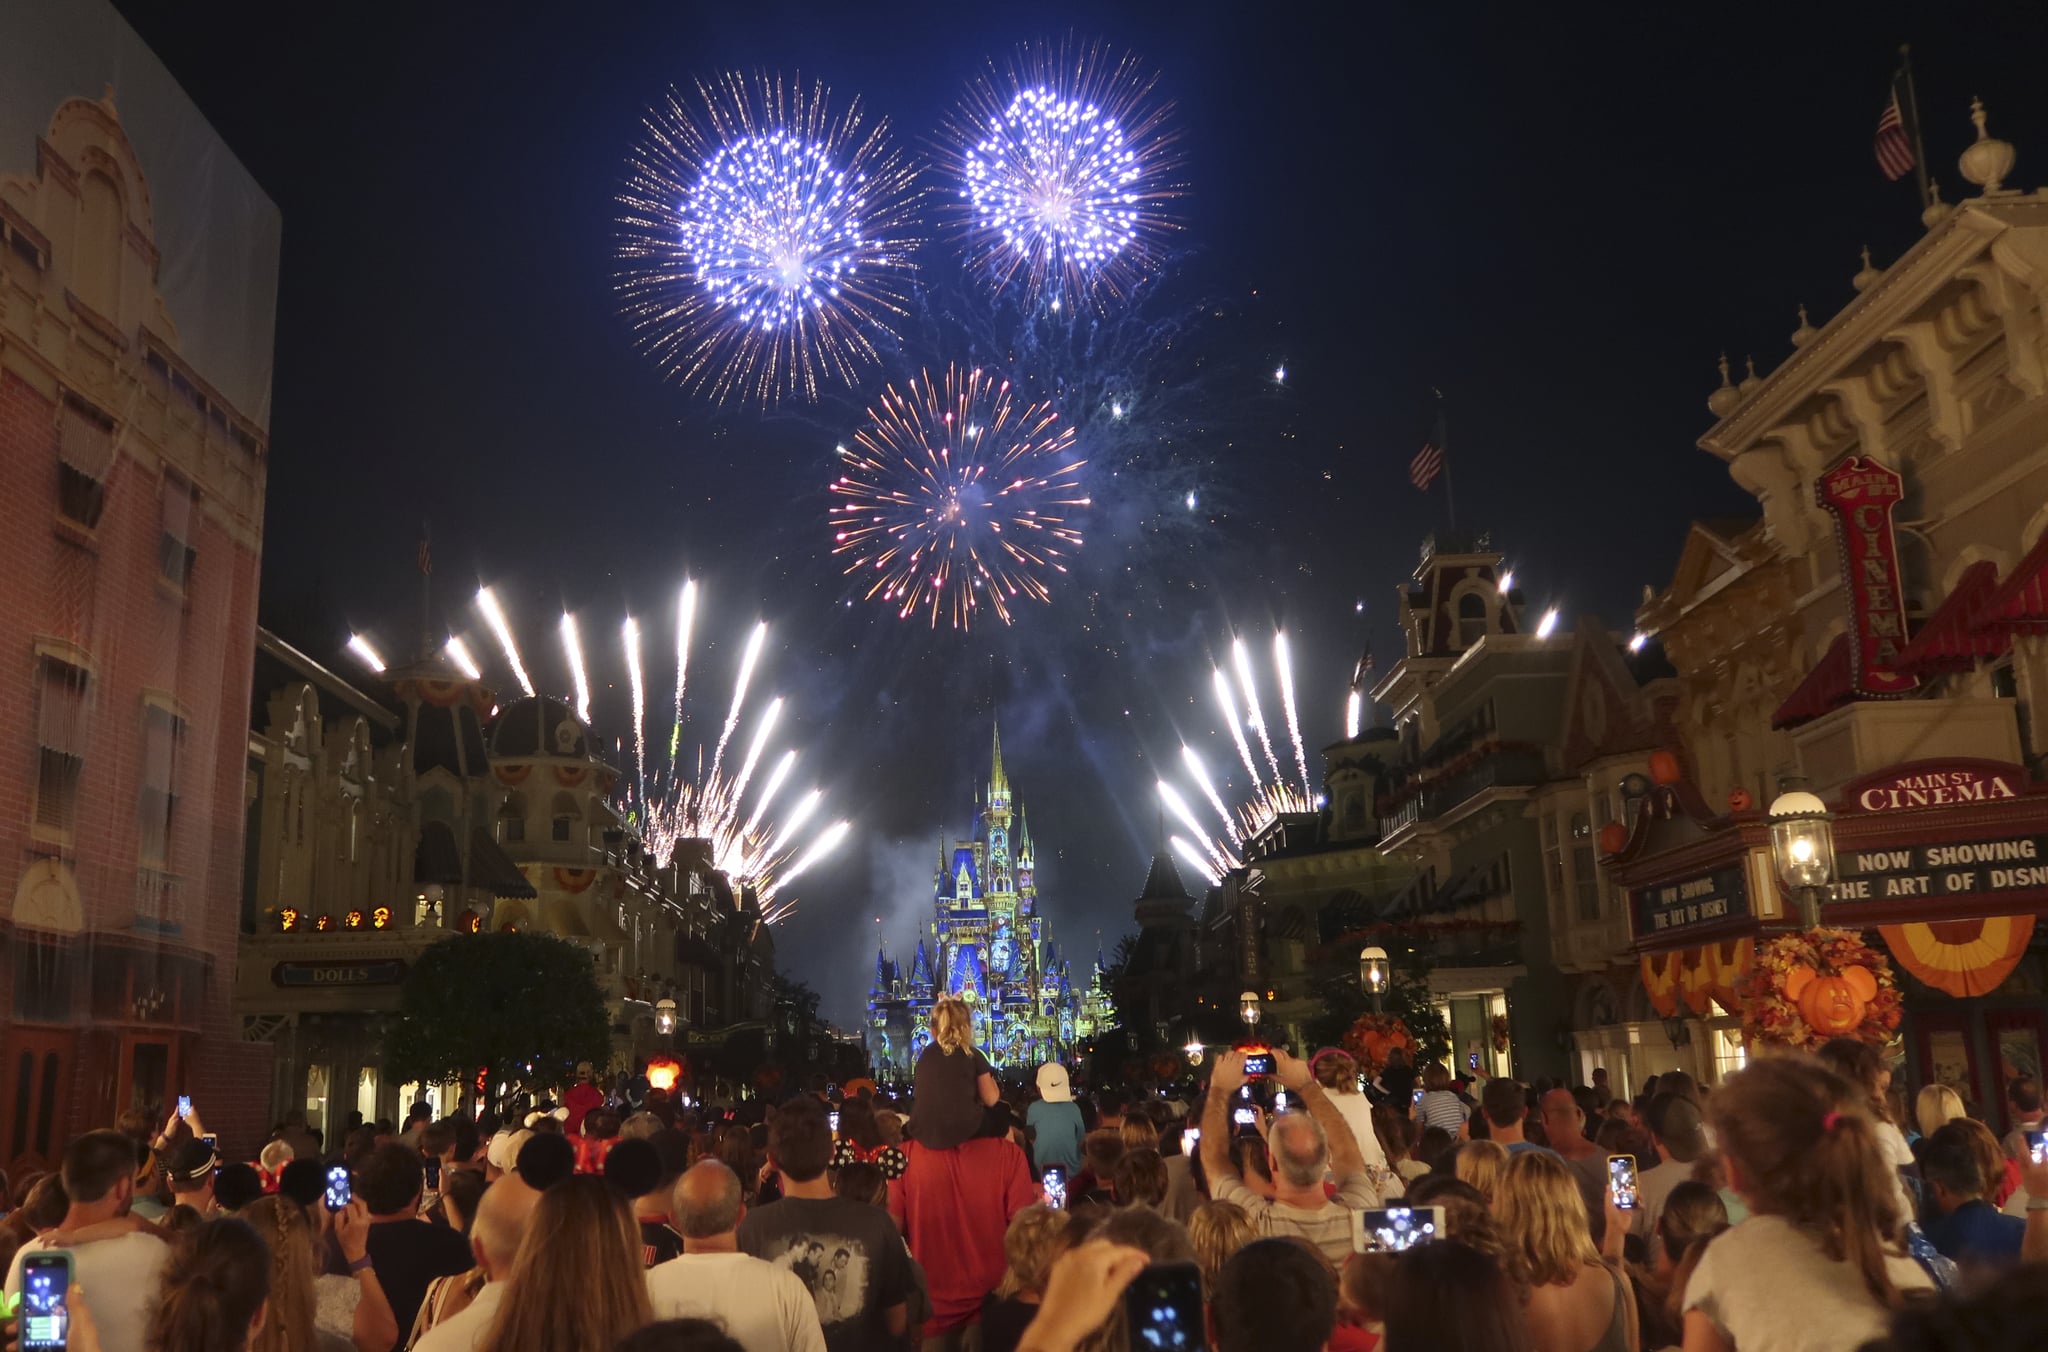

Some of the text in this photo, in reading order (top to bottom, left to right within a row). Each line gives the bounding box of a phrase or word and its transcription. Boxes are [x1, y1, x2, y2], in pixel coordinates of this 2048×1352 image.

[1830, 473, 1888, 495] MAIN
[1855, 505, 1901, 664] CINEMA
[1860, 776, 2016, 811] CINEMA
[1896, 771, 1974, 789] MAIN ST
[1858, 839, 2037, 872] NOW SHOWING
[1662, 888, 1677, 904] NOW
[1886, 876, 1931, 896] ART
[1945, 872, 1976, 892] OF
[1990, 865, 2048, 888] DISN
[1654, 898, 1727, 929] THE ART OF DISNEY
[313, 968, 368, 982] DOLLS
